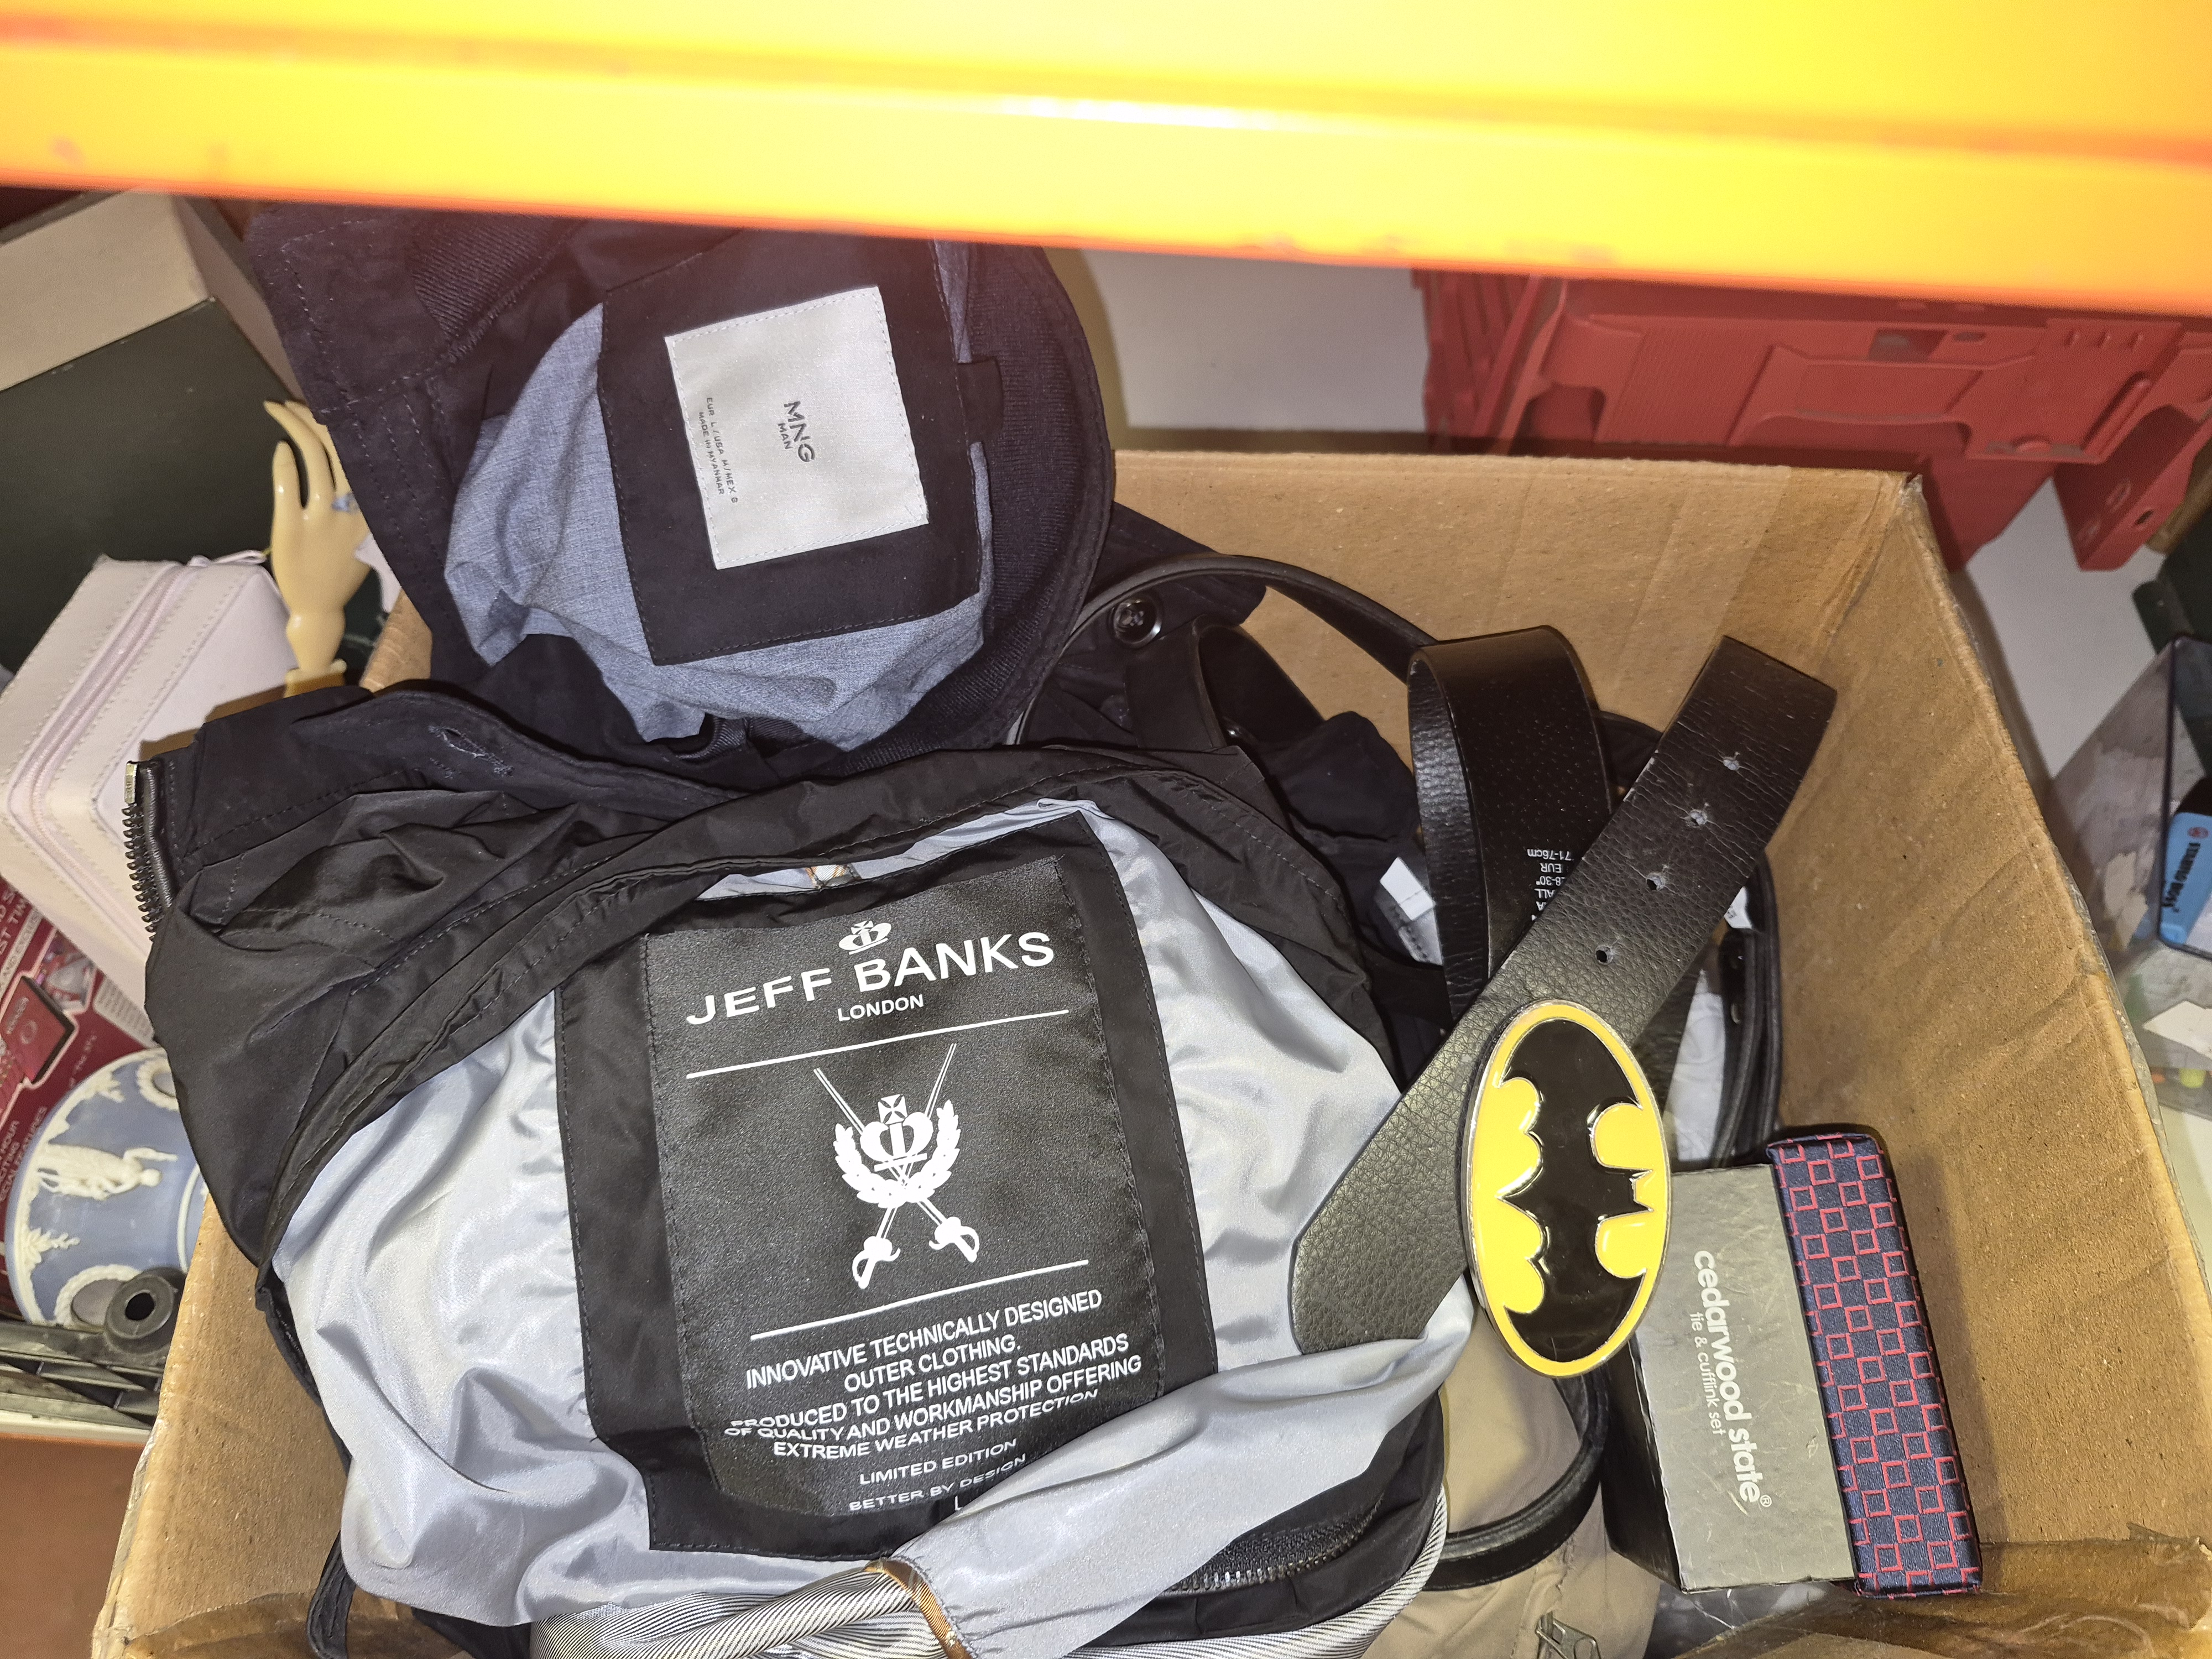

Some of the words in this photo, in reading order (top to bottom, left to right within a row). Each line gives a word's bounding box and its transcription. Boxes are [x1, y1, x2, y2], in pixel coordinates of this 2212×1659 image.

[698, 412, 709, 437] MADE
[706, 397, 714, 416] EUR
[705, 440, 712, 448] IN
[778, 423, 793, 449] MAN
[784, 401, 815, 462] MNG
[708, 451, 724, 494] MYANMAR
[1527, 849, 1572, 861] 71-76cm
[1540, 863, 1562, 873] EUR
[686, 968, 832, 1025] JEFF
[854, 931, 1055, 993] BANKS
[837, 994, 924, 1021] LONDON
[746, 1343, 867, 1390] INNOVATIVE
[870, 1310, 999, 1359] TECHNICALLY
[1005, 1289, 1102, 1327] DESIGNED
[1690, 1312, 1704, 1332] tie
[1694, 1250, 1752, 1421] cedarwood
[1694, 1336, 1708, 1348] &
[731, 1402, 847, 1428] PRODUCED
[851, 1394, 880, 1417] TO
[883, 1381, 924, 1408] THE
[928, 1359, 1013, 1397] HIGHEST
[1017, 1333, 1129, 1375] STANDARDS
[844, 1359, 916, 1392] OUTER
[918, 1334, 1021, 1373] CLOTHING.
[1698, 1352, 1720, 1408] cufflink
[724, 1427, 753, 1436] OF
[758, 1427, 842, 1441] QUALITY
[846, 1418, 890, 1440] AND
[894, 1379, 1042, 1431] WORKMANSHIP
[1047, 1355, 1142, 1394] OFFERING
[774, 1441, 871, 1459] EXTREME
[874, 1419, 973, 1452] WEATHER
[977, 1389, 1098, 1431] PROTECTION
[1709, 1412, 1726, 1436] set
[849, 1489, 925, 1511] BETTER
[930, 1481, 957, 1497] BY
[959, 1453, 1027, 1488] DESIGN
[859, 1460, 937, 1485] LIMITED
[941, 1438, 1017, 1470] EDITION
